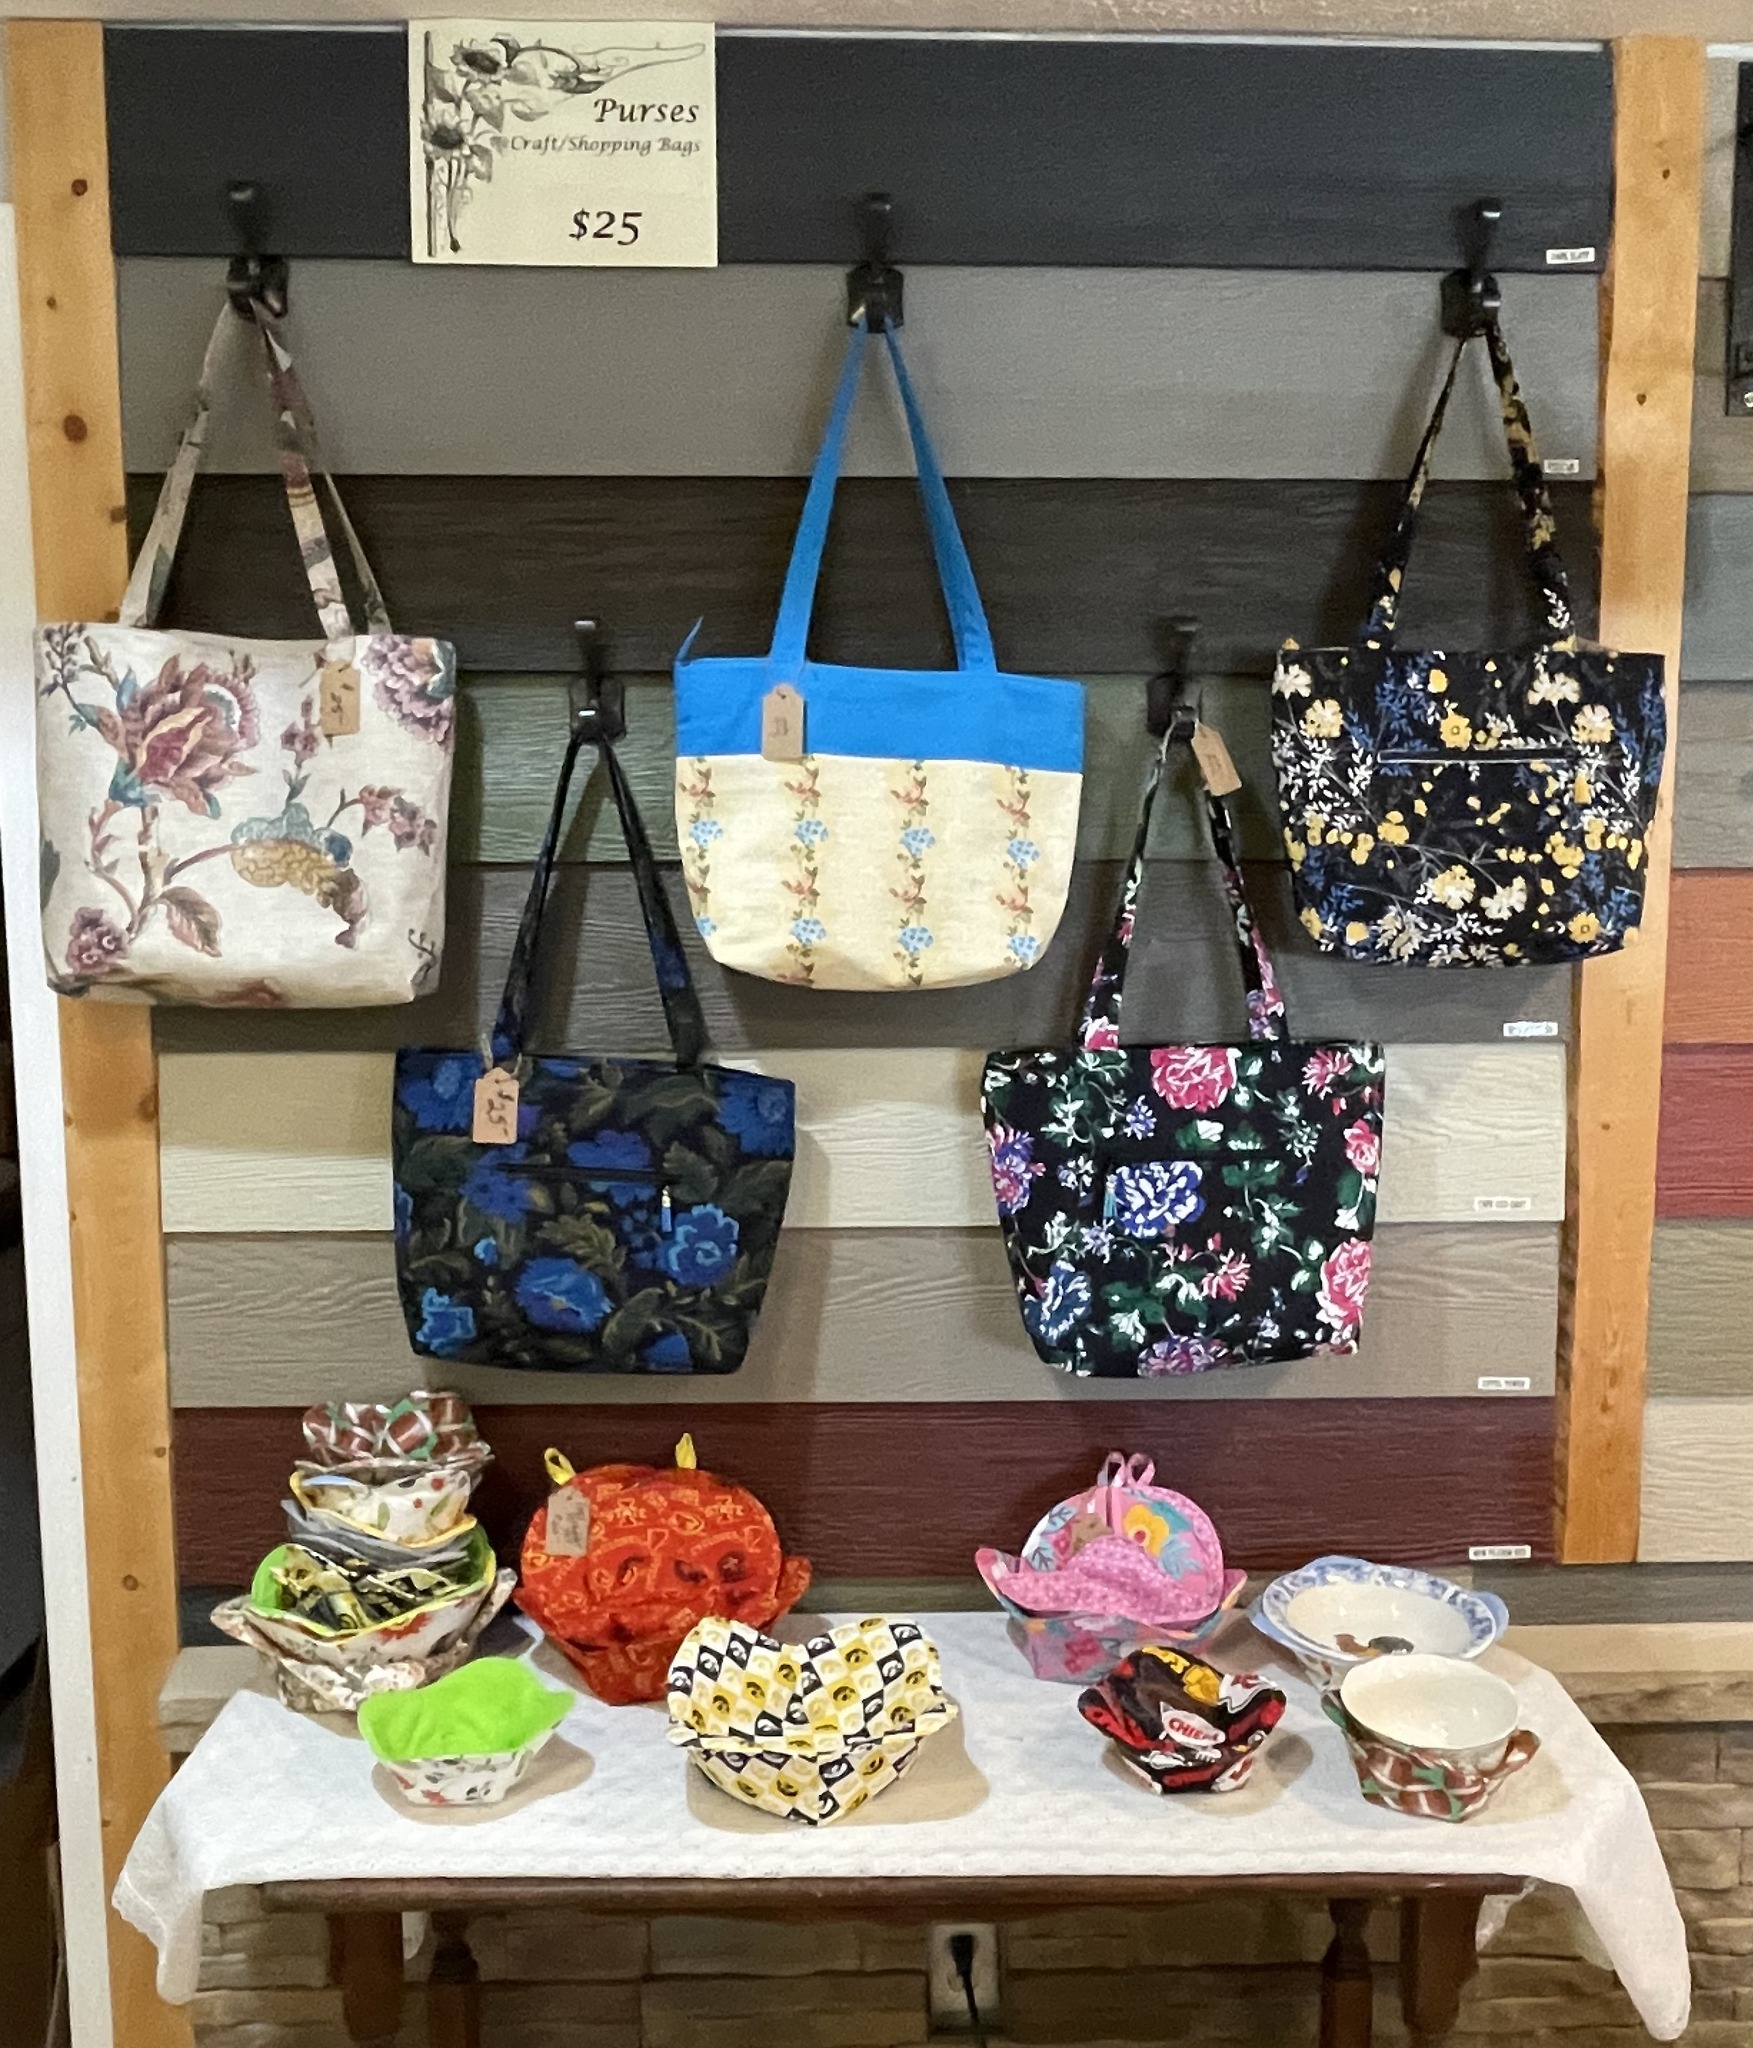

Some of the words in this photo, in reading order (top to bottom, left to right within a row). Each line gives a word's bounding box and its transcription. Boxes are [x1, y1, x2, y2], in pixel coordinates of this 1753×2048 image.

[593, 97, 700, 123] Purses
[510, 135, 651, 157] Craft/Shopping
[657, 136, 701, 157] Bags
[568, 208, 643, 246] $25
